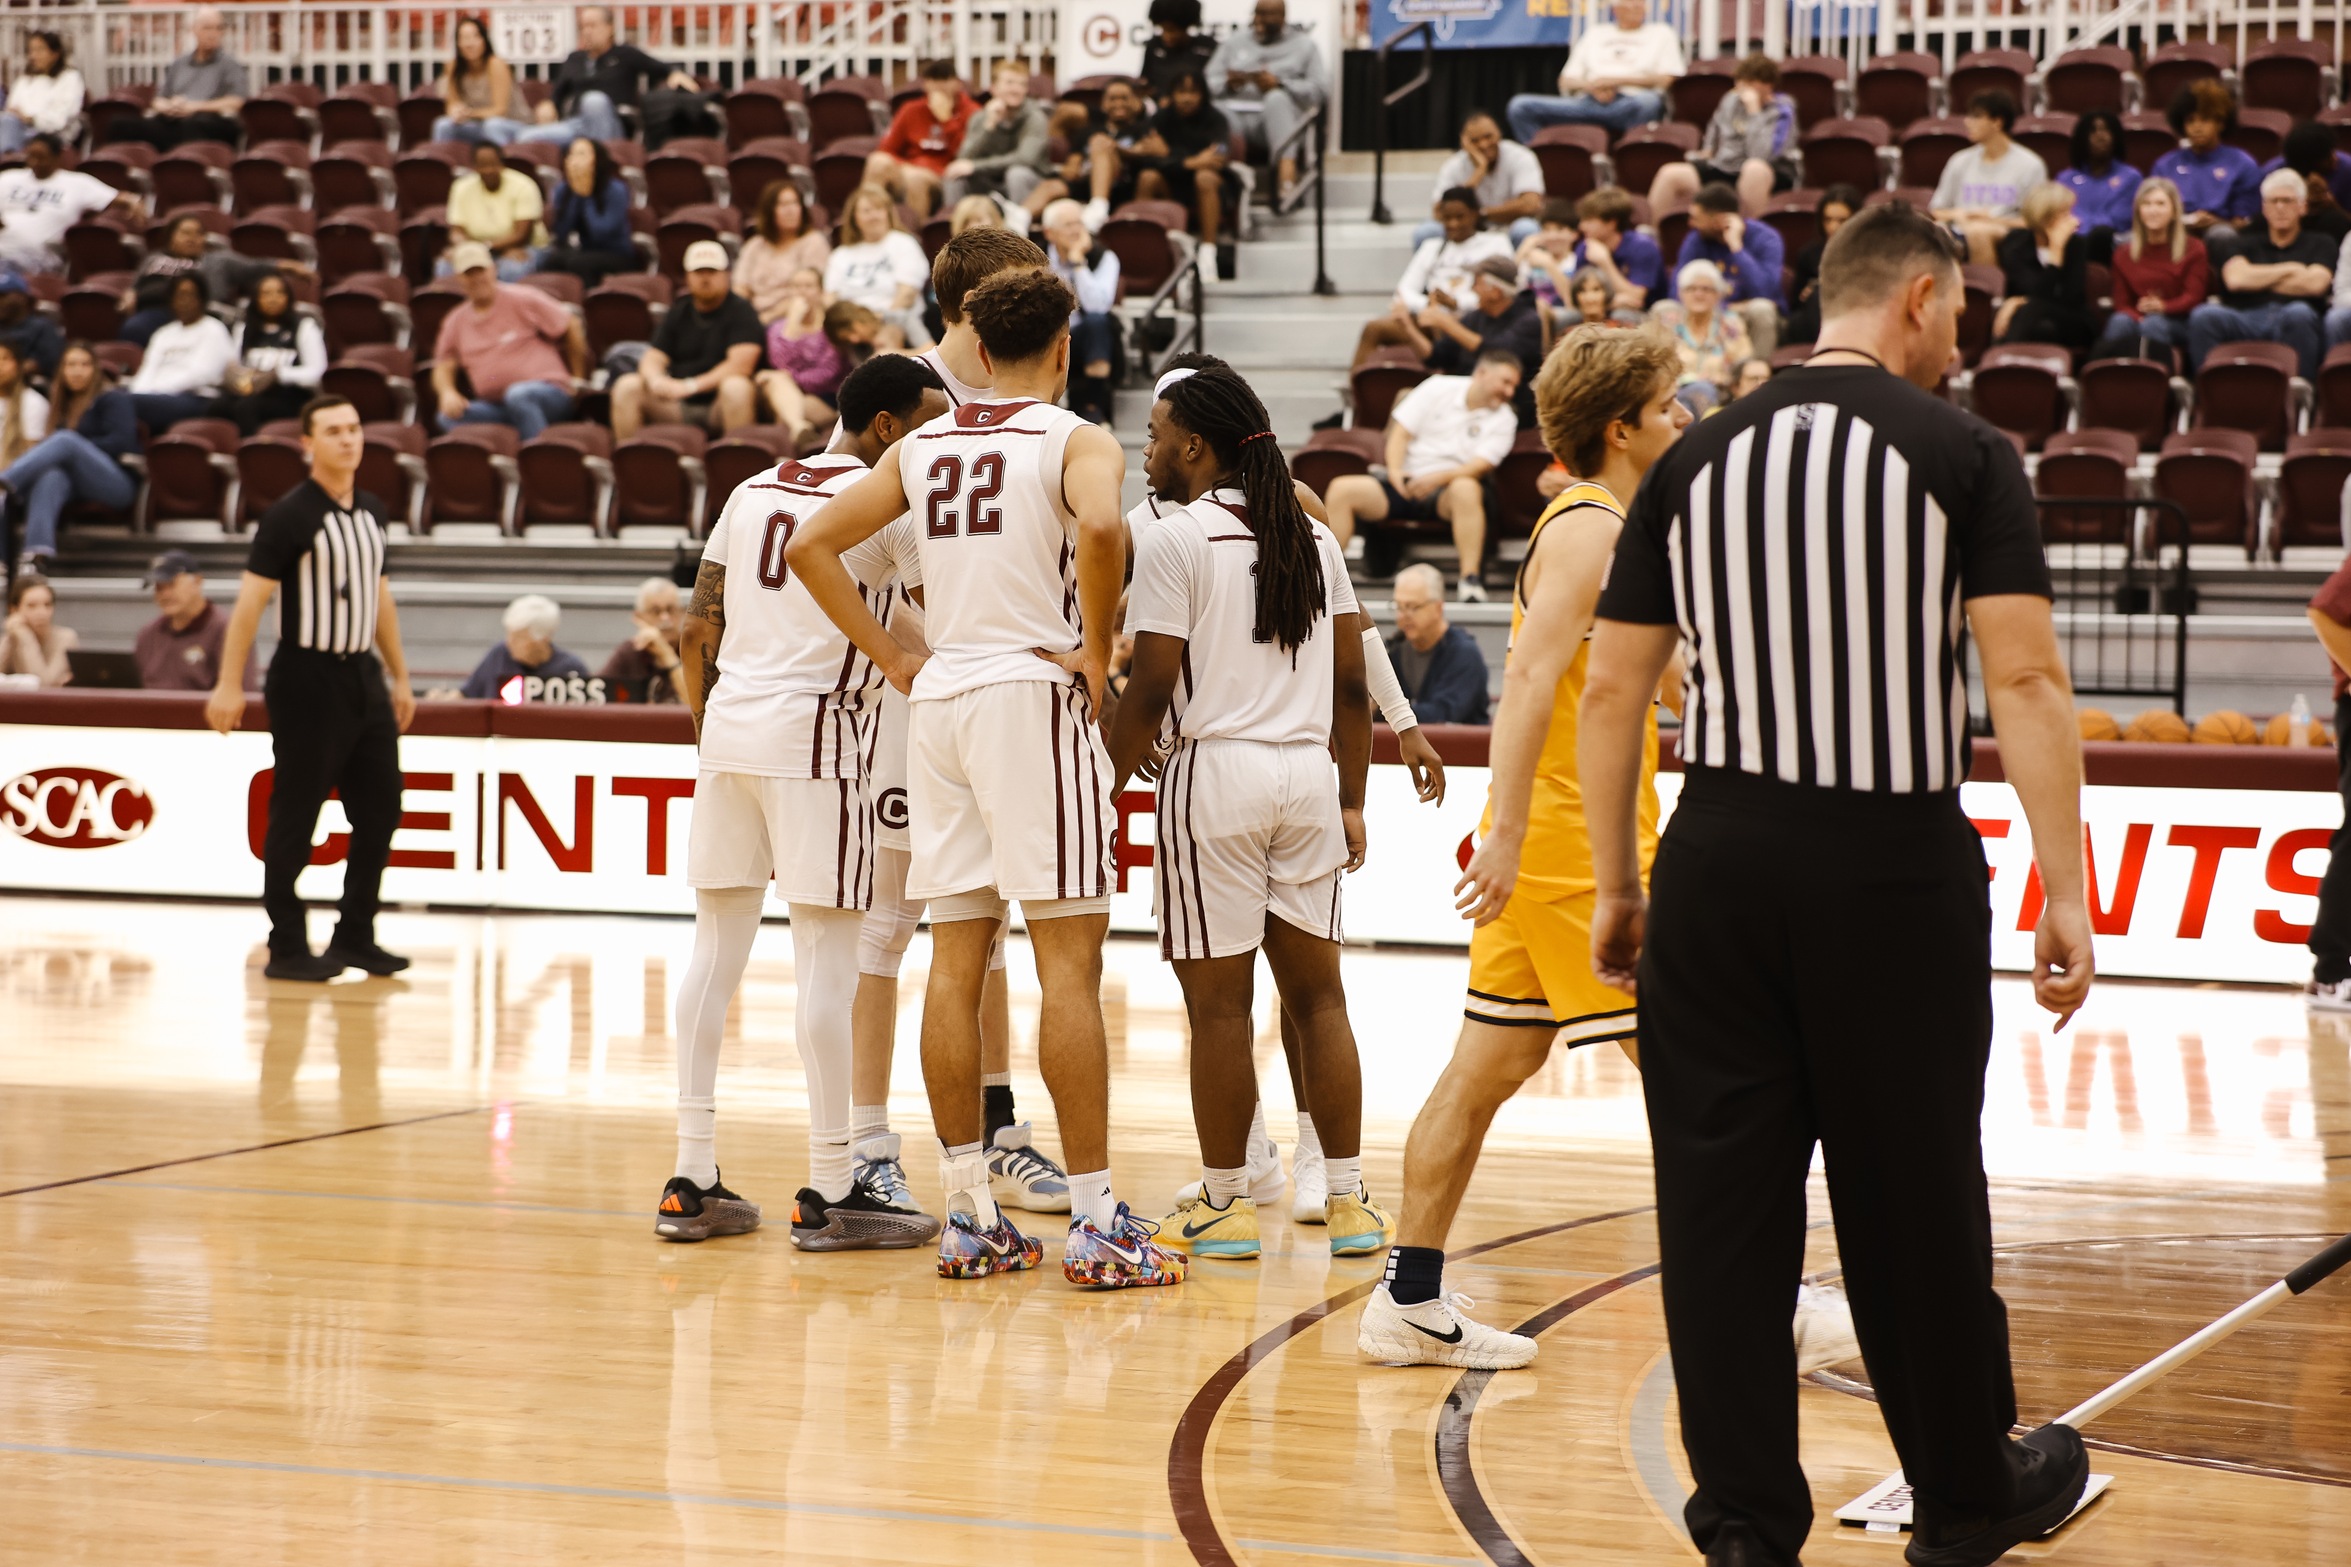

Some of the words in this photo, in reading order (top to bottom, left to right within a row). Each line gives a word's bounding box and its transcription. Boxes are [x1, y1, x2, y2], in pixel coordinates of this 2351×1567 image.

[505, 28, 557, 54] 103
[926, 451, 1007, 540] 22
[757, 509, 799, 592] 0
[524, 676, 607, 705] POSS
[2, 775, 144, 841] SCAC
